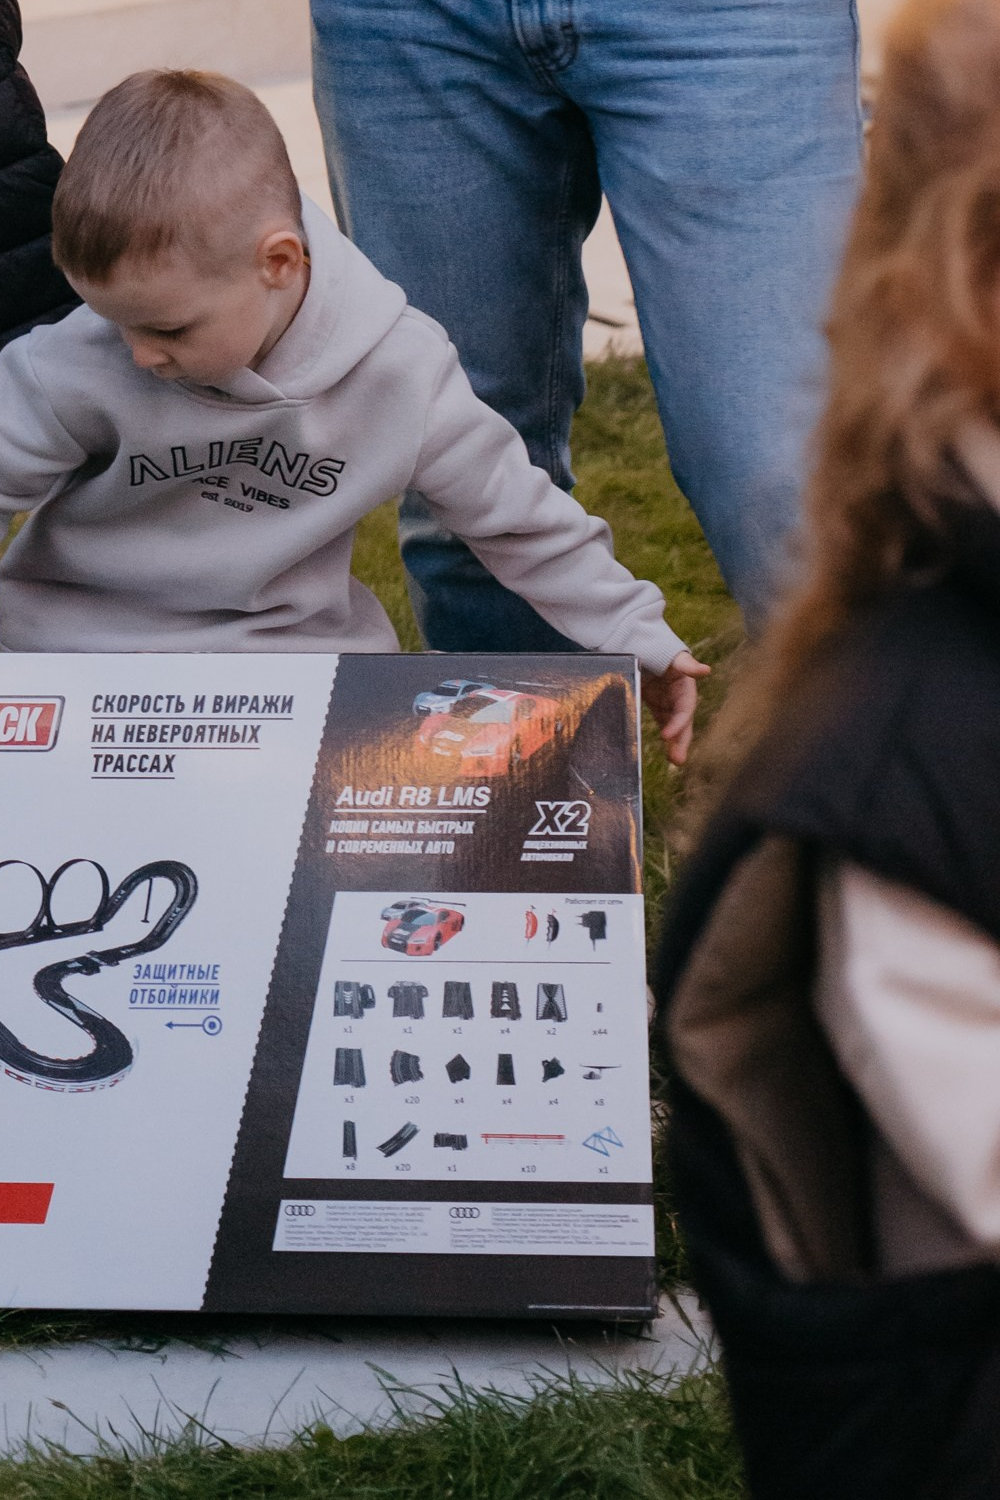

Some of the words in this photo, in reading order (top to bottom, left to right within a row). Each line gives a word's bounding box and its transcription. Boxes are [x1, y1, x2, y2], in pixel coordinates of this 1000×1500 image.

[130, 437, 345, 497] ALIENS
[191, 475, 230, 489] ACE
[240, 482, 290, 510] VIBES
[91, 694, 186, 714] СКОРОСТЬ
[192, 694, 206, 714] И
[211, 694, 294, 714] ВИРАЖИ
[91, 724, 116, 744] НА
[122, 724, 262, 744] НЕВЕРОЯТНЫХ
[92, 753, 176, 773] ТРАССАХ
[335, 785, 395, 807] Audi
[397, 785, 432, 807] R8
[436, 786, 492, 808] LMS
[370, 820, 416, 834] САМЫХ
[416, 820, 476, 835] БЫСТРЫХ
[528, 800, 592, 836] X2
[336, 840, 425, 854] СОВРЕМЕННЫХ
[424, 840, 456, 854] АВТО
[132, 964, 221, 982] ЗАЩИТНЫЕ
[128, 984, 221, 1005] ОТБОЙНИКИ
[546, 1027, 557, 1036] x2
[395, 1163, 412, 1171] x20
